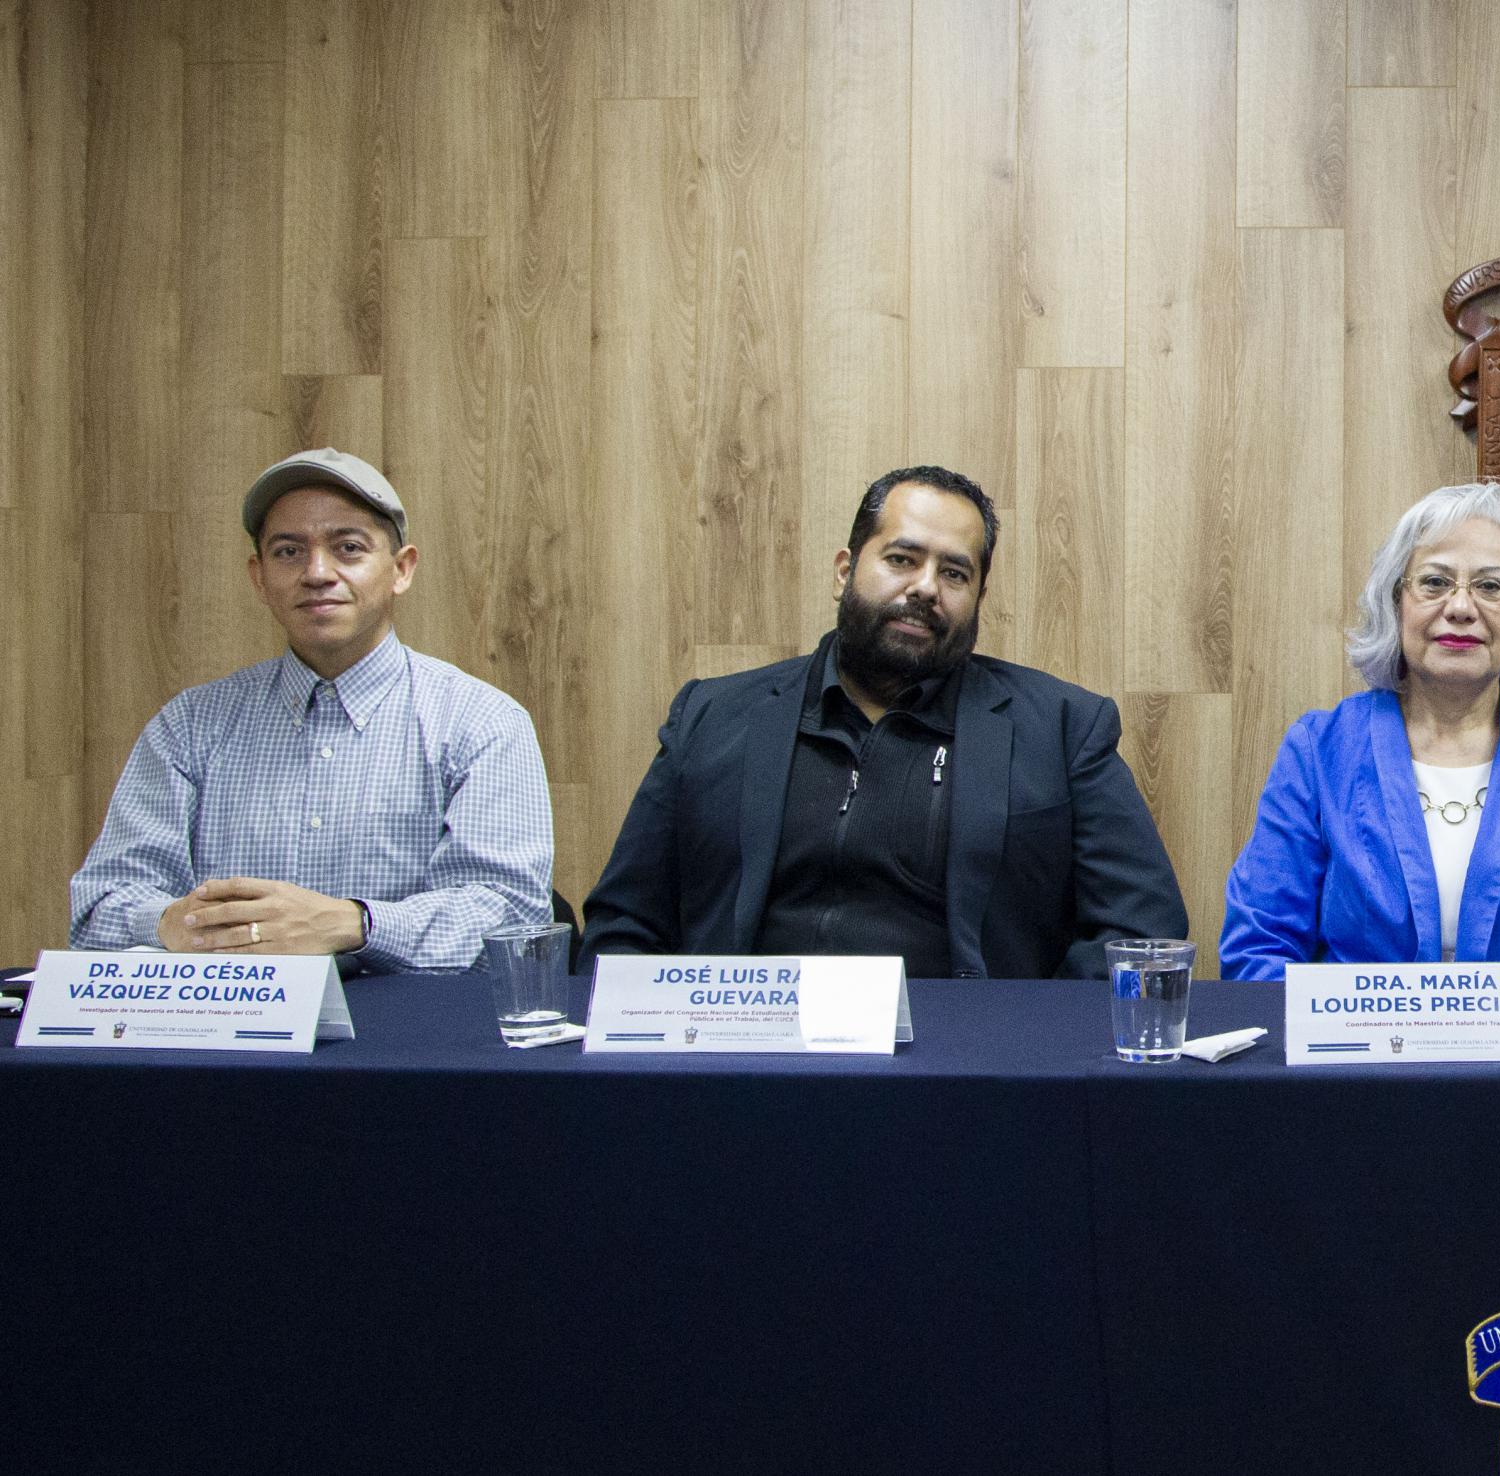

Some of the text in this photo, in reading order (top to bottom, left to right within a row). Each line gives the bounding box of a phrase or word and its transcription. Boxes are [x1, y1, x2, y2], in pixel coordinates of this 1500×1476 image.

[89, 962, 276, 980] DR. JULIO CÉSAR
[653, 965, 712, 984] JOSÉ
[720, 968, 768, 984] LUIS
[1356, 975, 1412, 990] DRA.
[1420, 971, 1498, 990] MARÍA
[69, 980, 286, 1002] VÁZQUEZ COLUNGA
[690, 990, 799, 1005] GUEVARA
[1311, 997, 1422, 1013] LOURDES
